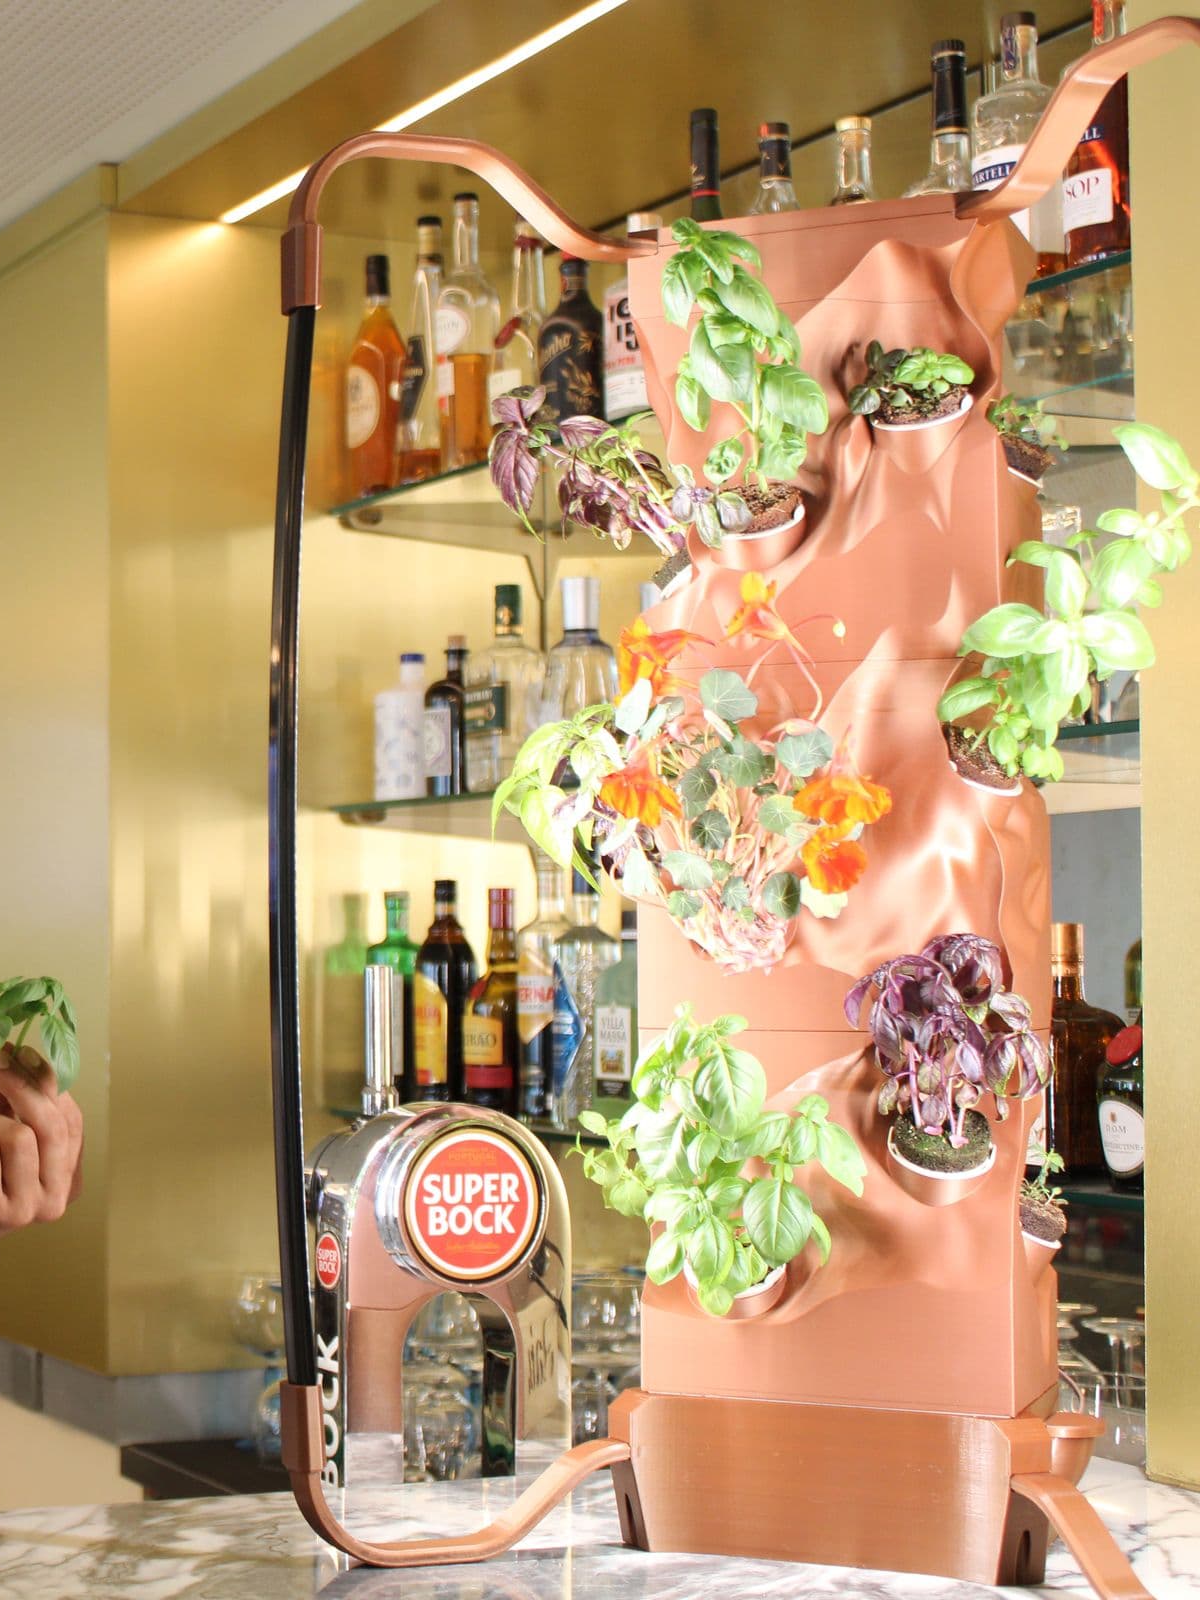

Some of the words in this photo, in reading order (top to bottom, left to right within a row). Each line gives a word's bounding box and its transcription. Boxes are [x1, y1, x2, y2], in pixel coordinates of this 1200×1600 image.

[423, 1172, 520, 1205] SUPER
[428, 1203, 516, 1236] BOCK
[318, 1247, 337, 1261] SUPER
[319, 1260, 337, 1275] BOCK
[317, 1333, 339, 1490] BOCK
